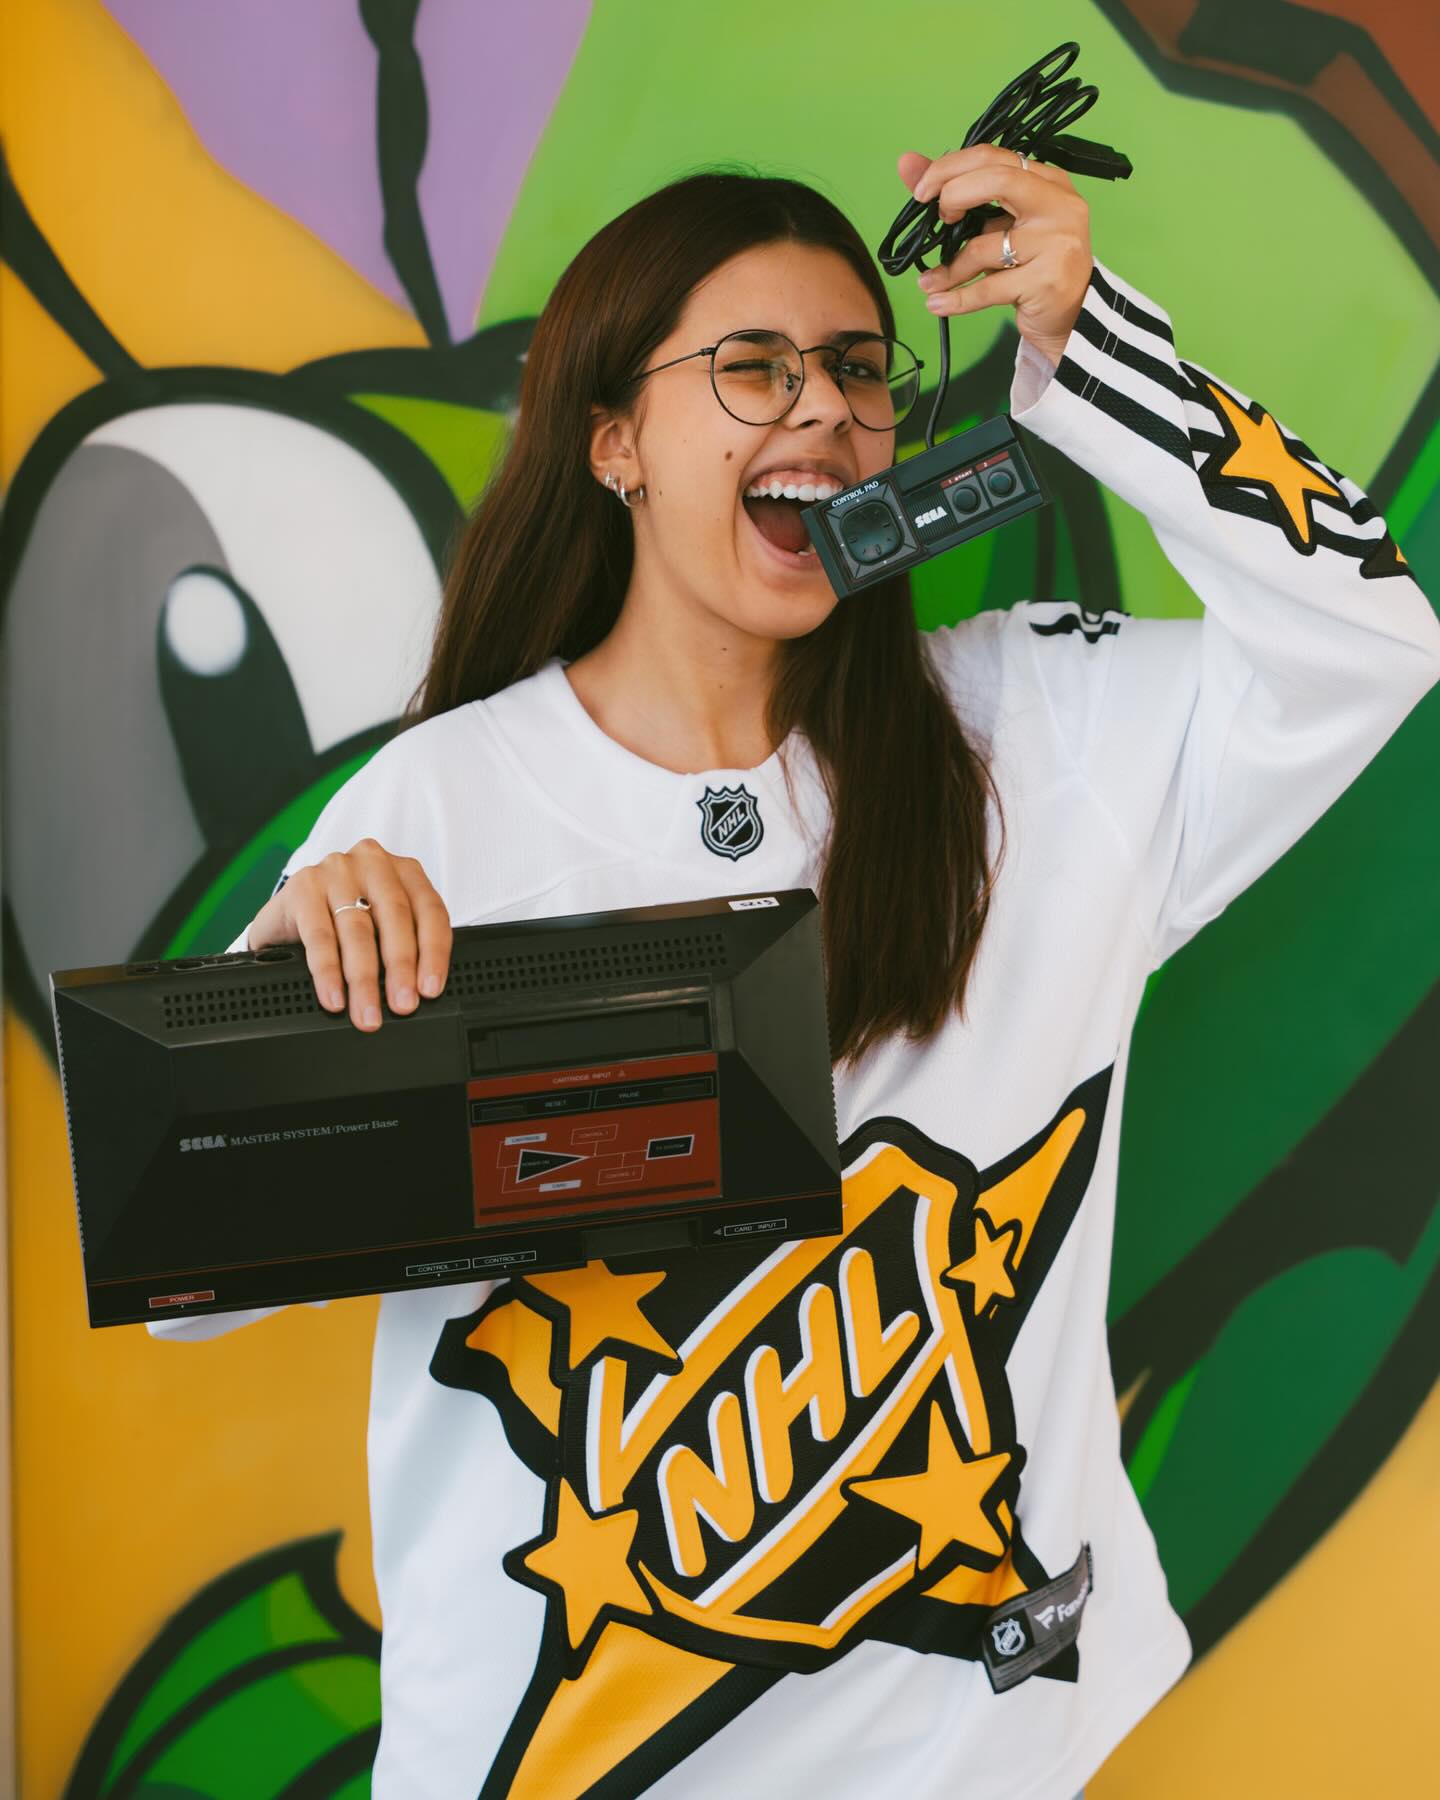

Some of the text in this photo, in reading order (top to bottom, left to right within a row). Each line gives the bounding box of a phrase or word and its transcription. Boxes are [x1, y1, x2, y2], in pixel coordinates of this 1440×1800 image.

[831, 480, 880, 508] CONTROL PAD
[914, 506, 948, 529] SEGA
[717, 806, 745, 841] NHL
[179, 1135, 227, 1152] SEGA
[230, 1132, 281, 1146] MASTER
[371, 1119, 399, 1129] Base
[418, 1264, 449, 1273] CONTROL
[484, 1256, 516, 1264] CONTROL
[168, 1295, 195, 1303] POWER
[656, 1246, 920, 1578] NHL
